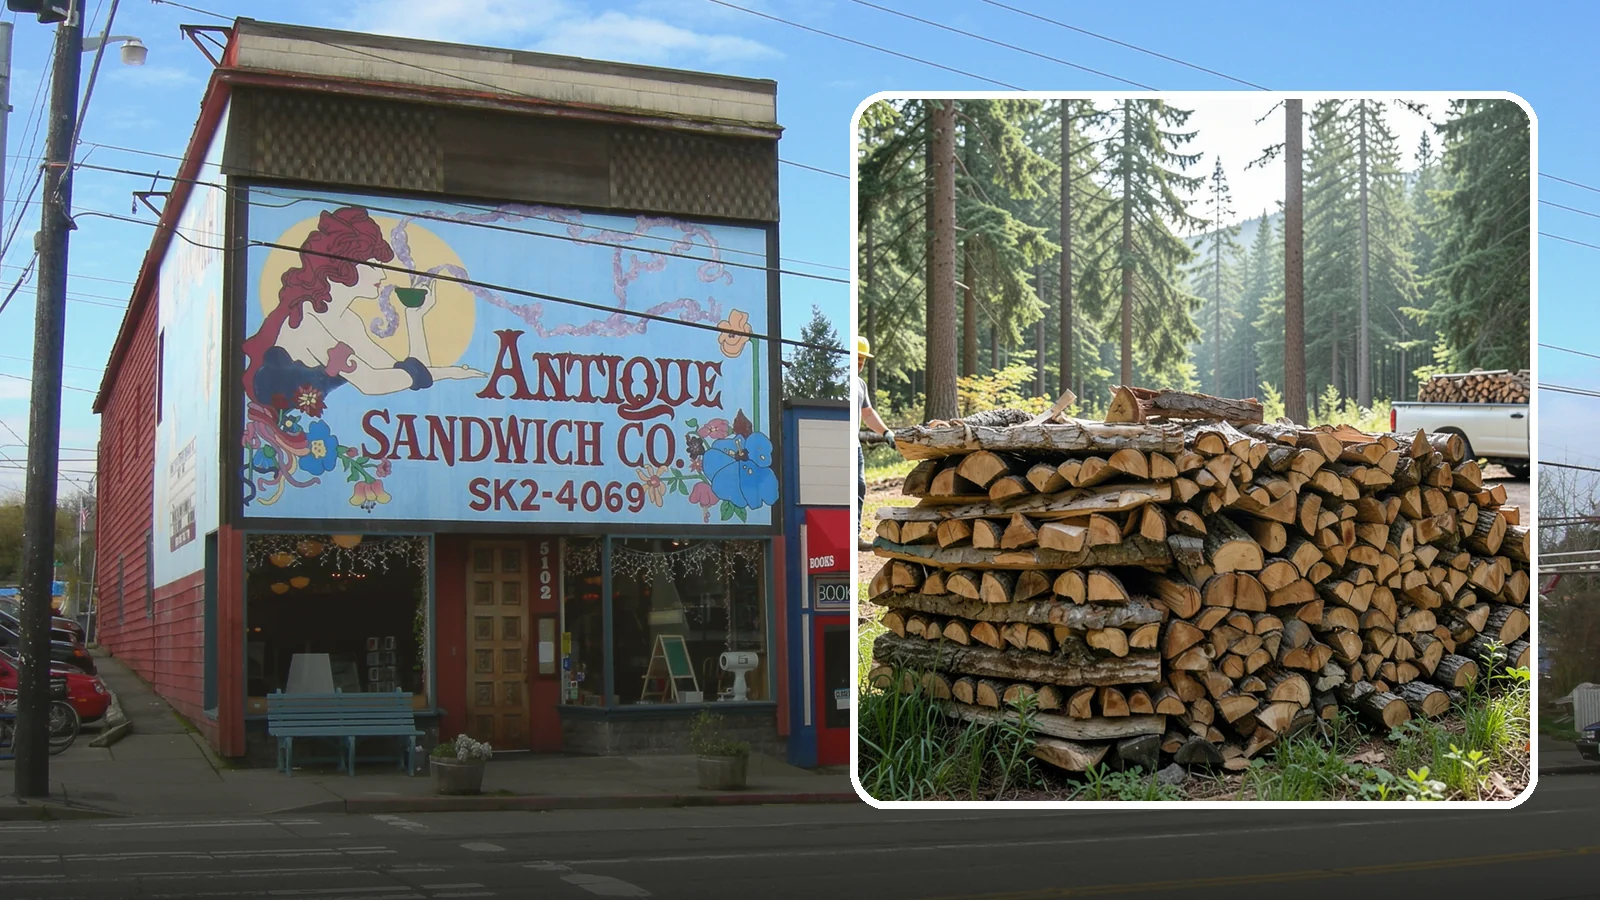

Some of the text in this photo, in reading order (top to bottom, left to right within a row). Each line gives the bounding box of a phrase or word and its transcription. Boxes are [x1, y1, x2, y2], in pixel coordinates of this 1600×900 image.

[475, 329, 724, 421] ANTIQUE
[361, 408, 685, 468] SANDWICH CO.
[467, 476, 646, 513] SK2-4069
[539, 541, 552, 600] 5102
[809, 555, 835, 569] BOOKS
